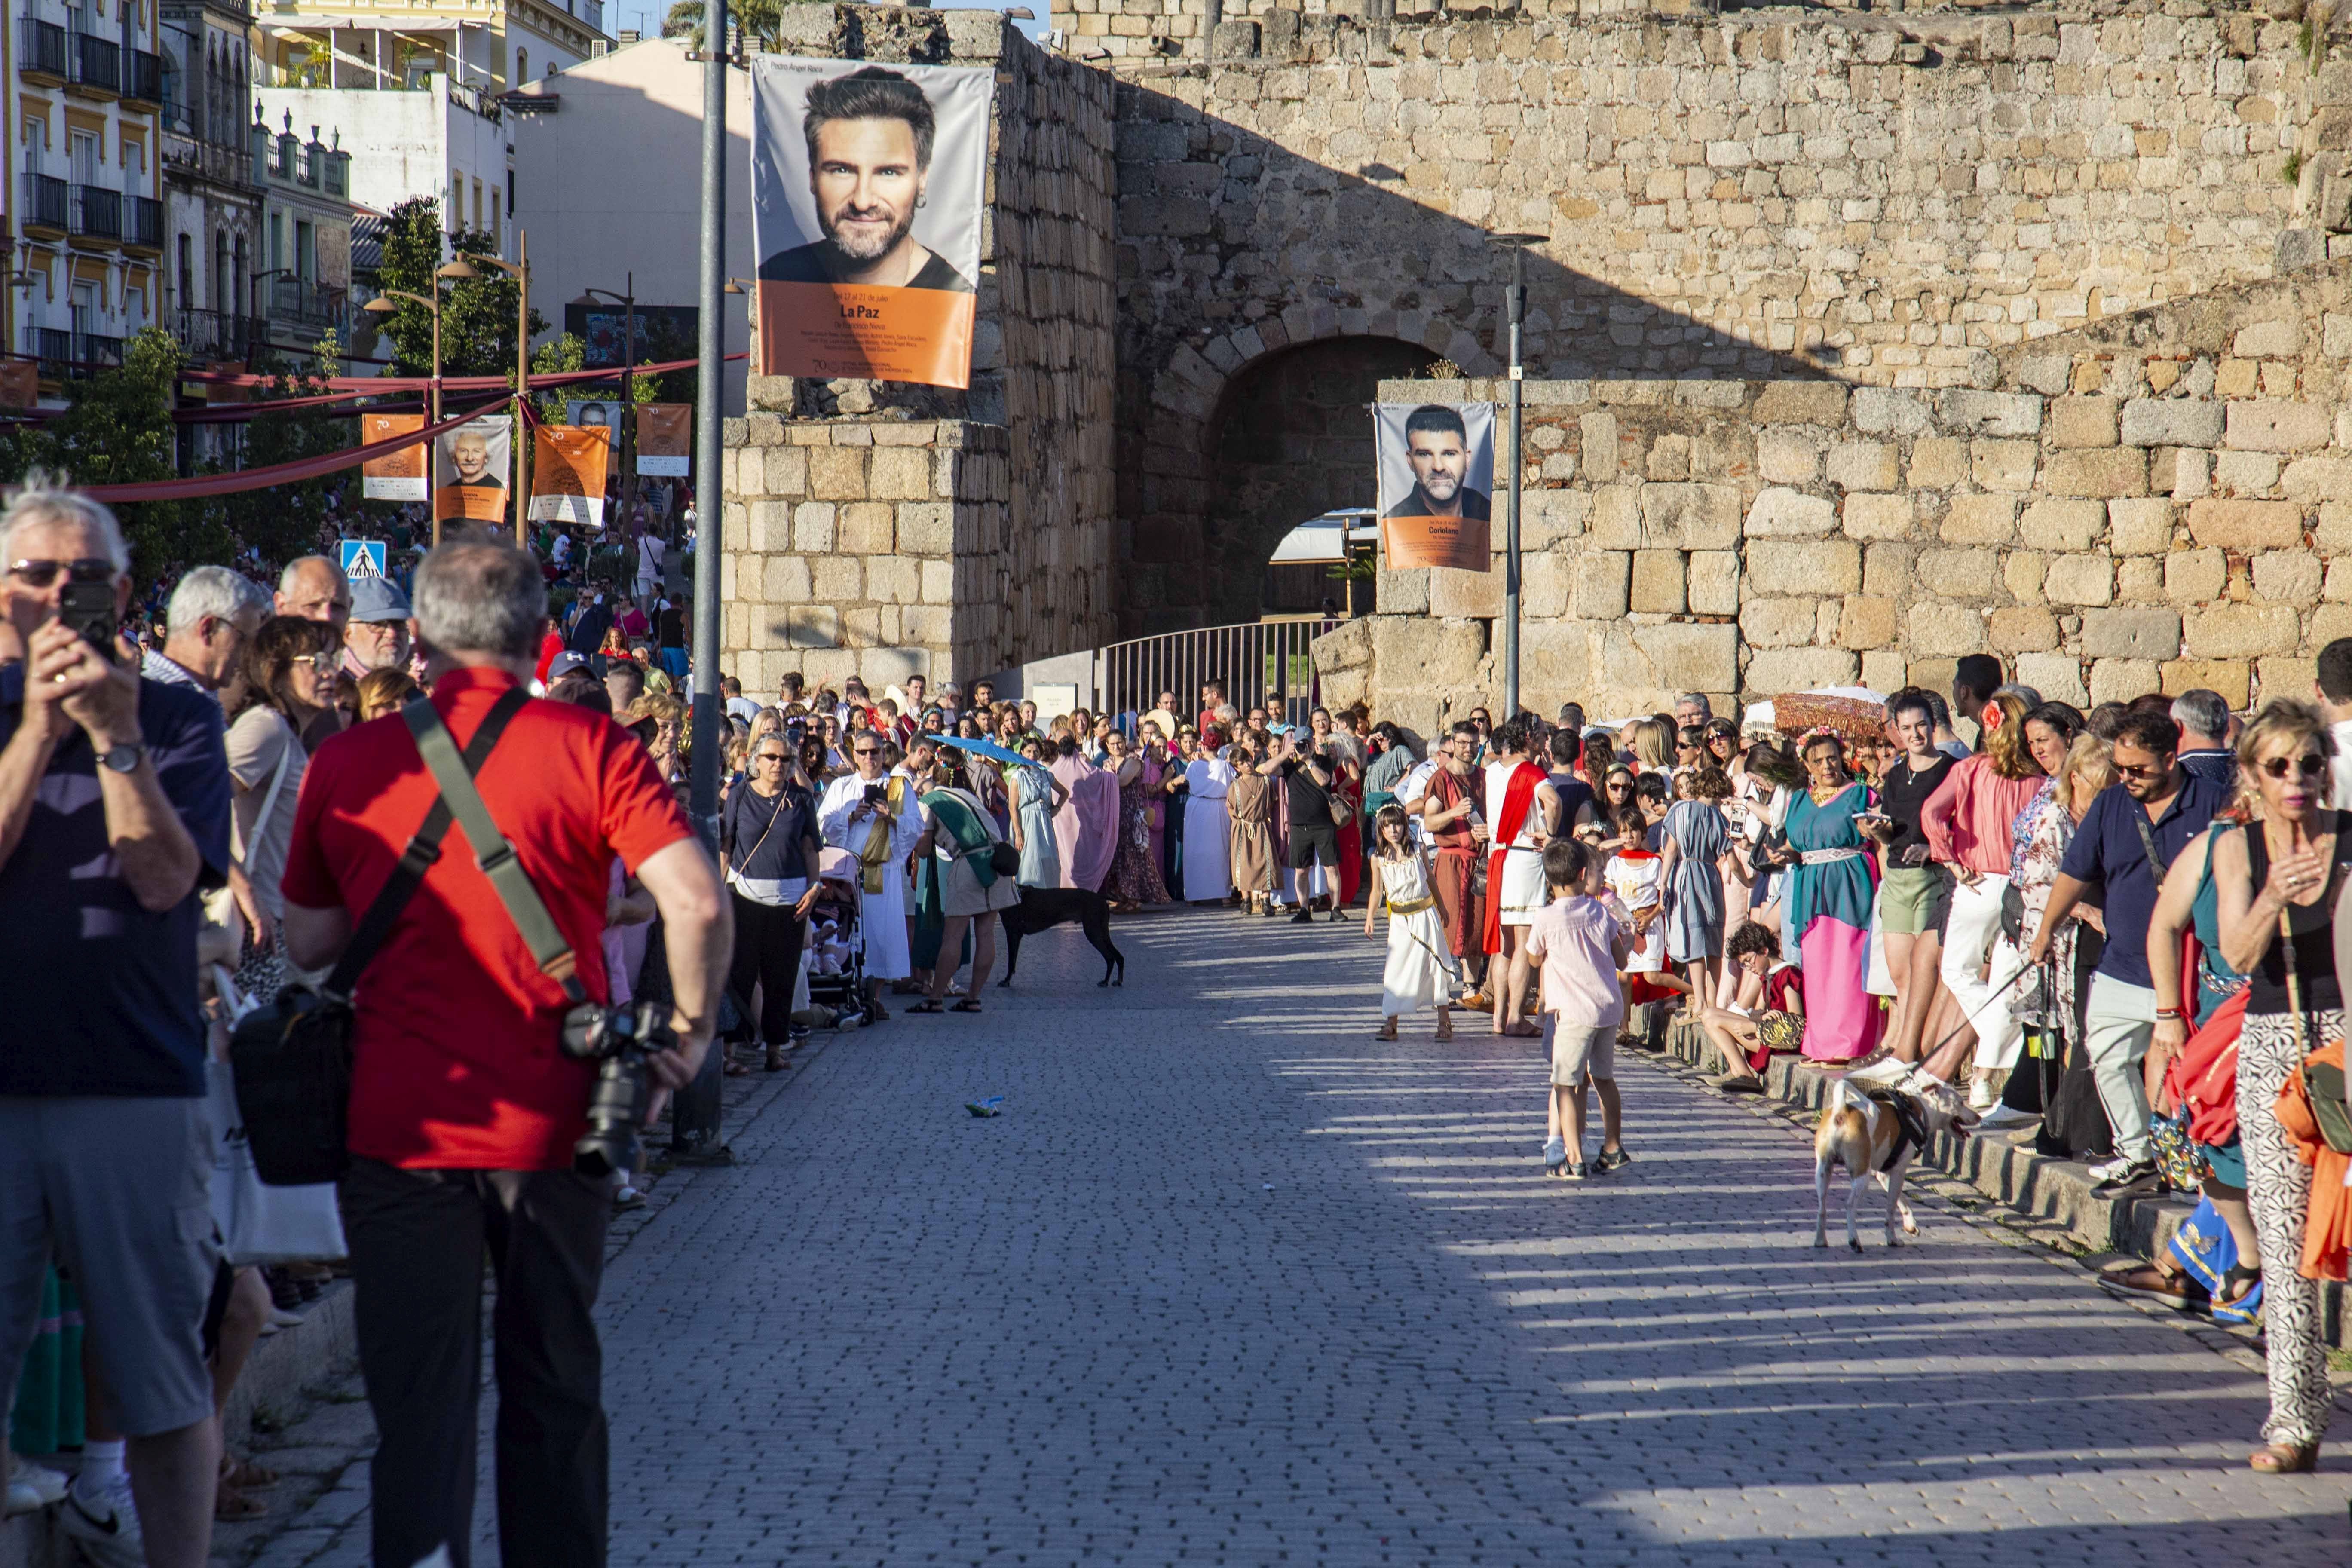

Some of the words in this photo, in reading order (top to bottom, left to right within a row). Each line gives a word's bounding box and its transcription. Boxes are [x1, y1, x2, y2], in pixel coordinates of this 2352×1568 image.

[771, 60, 788, 70] Pedro
[808, 65, 823, 73] Roca
[833, 292, 843, 300] Del
[876, 294, 888, 303] julio
[841, 304, 854, 318] La
[857, 305, 880, 319] Paz
[377, 420, 389, 431] 70
[550, 432, 564, 442] 70
[1429, 527, 1459, 535] Coriolano
